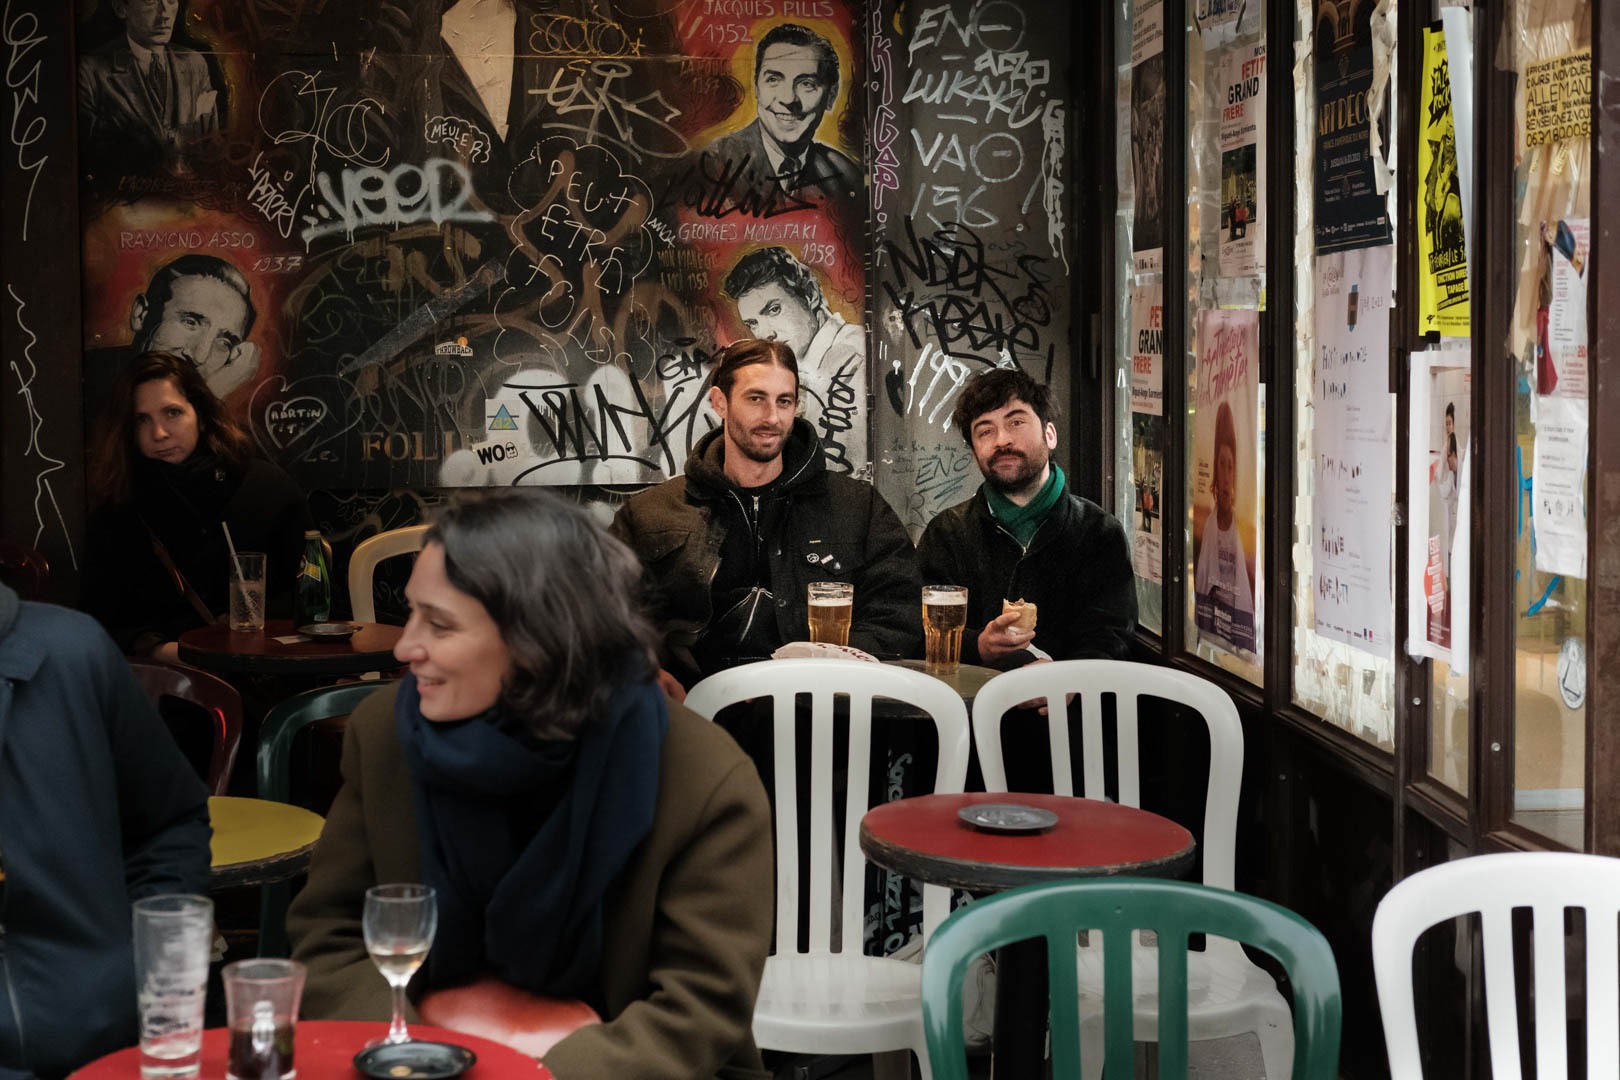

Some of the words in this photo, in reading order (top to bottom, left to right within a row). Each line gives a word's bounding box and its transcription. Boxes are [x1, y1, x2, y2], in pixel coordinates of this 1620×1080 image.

[703, 0, 775, 18] JACQUES
[782, 0, 835, 17] PILLS
[702, 22, 754, 43] 1952
[1228, 77, 1260, 105] GRAND
[1318, 101, 1337, 137] ART
[120, 231, 202, 249] RAYMOND
[207, 231, 255, 249] ASSO
[679, 223, 737, 240] GEORGES
[744, 223, 817, 240] MOUSTAKI
[802, 243, 836, 266] 1958
[251, 256, 302, 273] 1937
